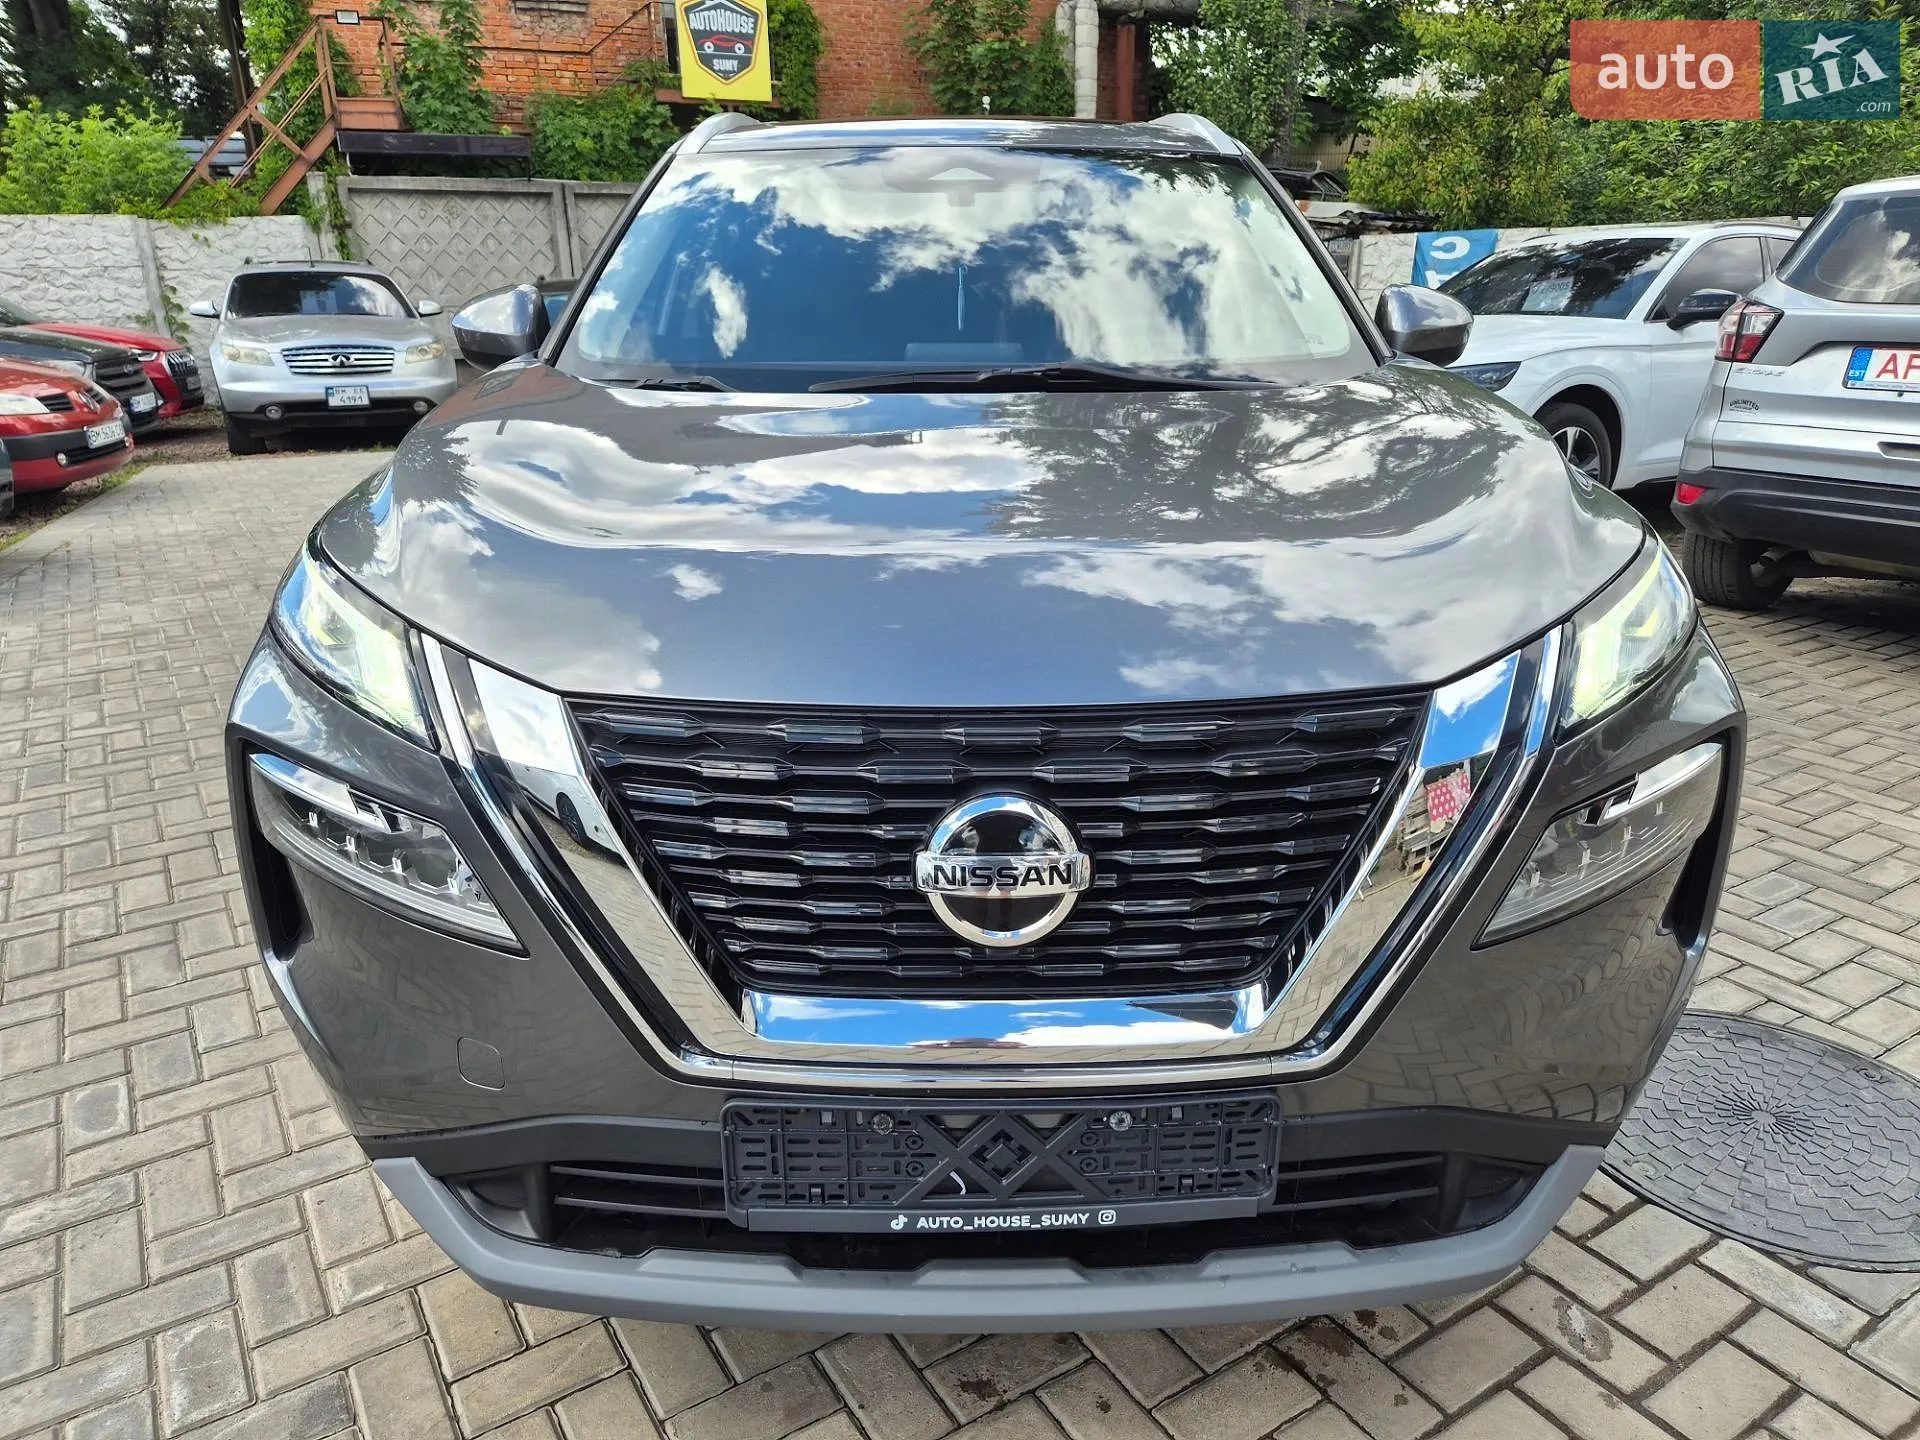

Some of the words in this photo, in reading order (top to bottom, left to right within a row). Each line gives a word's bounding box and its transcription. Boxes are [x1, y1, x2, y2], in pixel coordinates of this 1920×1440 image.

[689, 9, 755, 34] AUTOHOUSE
[713, 59, 738, 72] SUMY
[1849, 369, 1866, 377] EST
[933, 864, 1072, 887] NISSAN
[917, 1212, 1090, 1230] AUTO_HOUSE_SUMY
